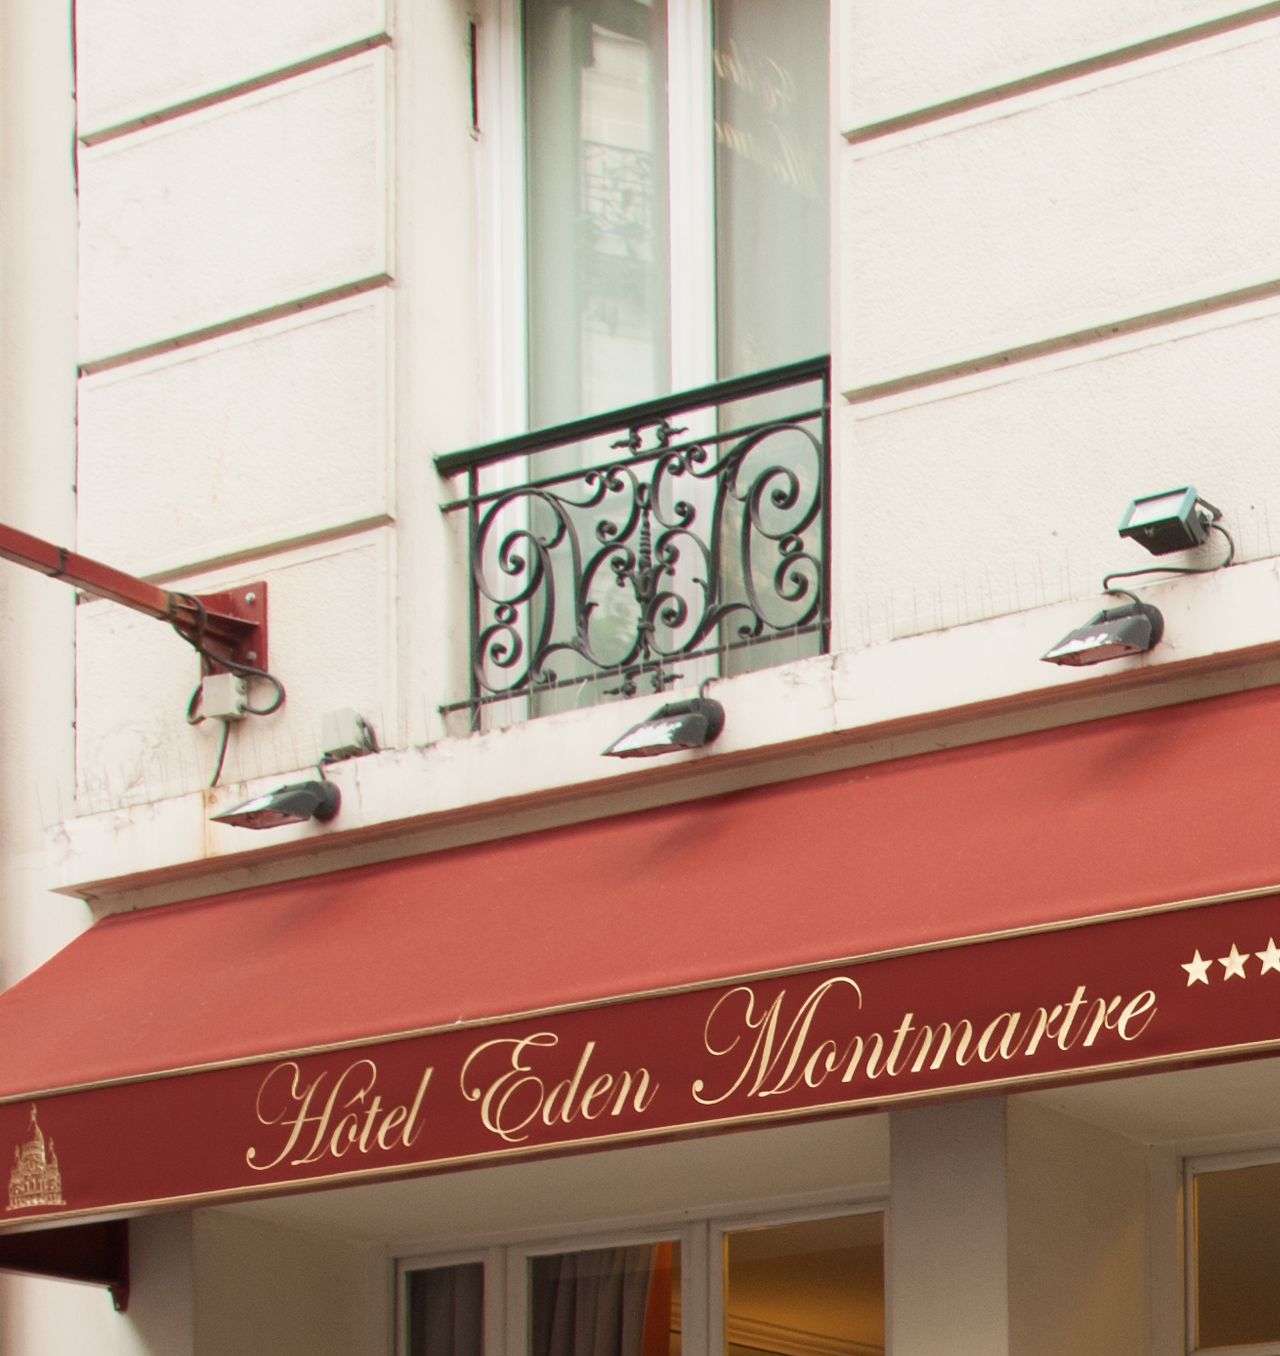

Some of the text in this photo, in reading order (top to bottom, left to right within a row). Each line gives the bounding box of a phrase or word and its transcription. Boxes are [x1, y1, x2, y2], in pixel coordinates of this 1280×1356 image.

[246, 977, 1157, 1171] Hôtel Eden Montmartre
